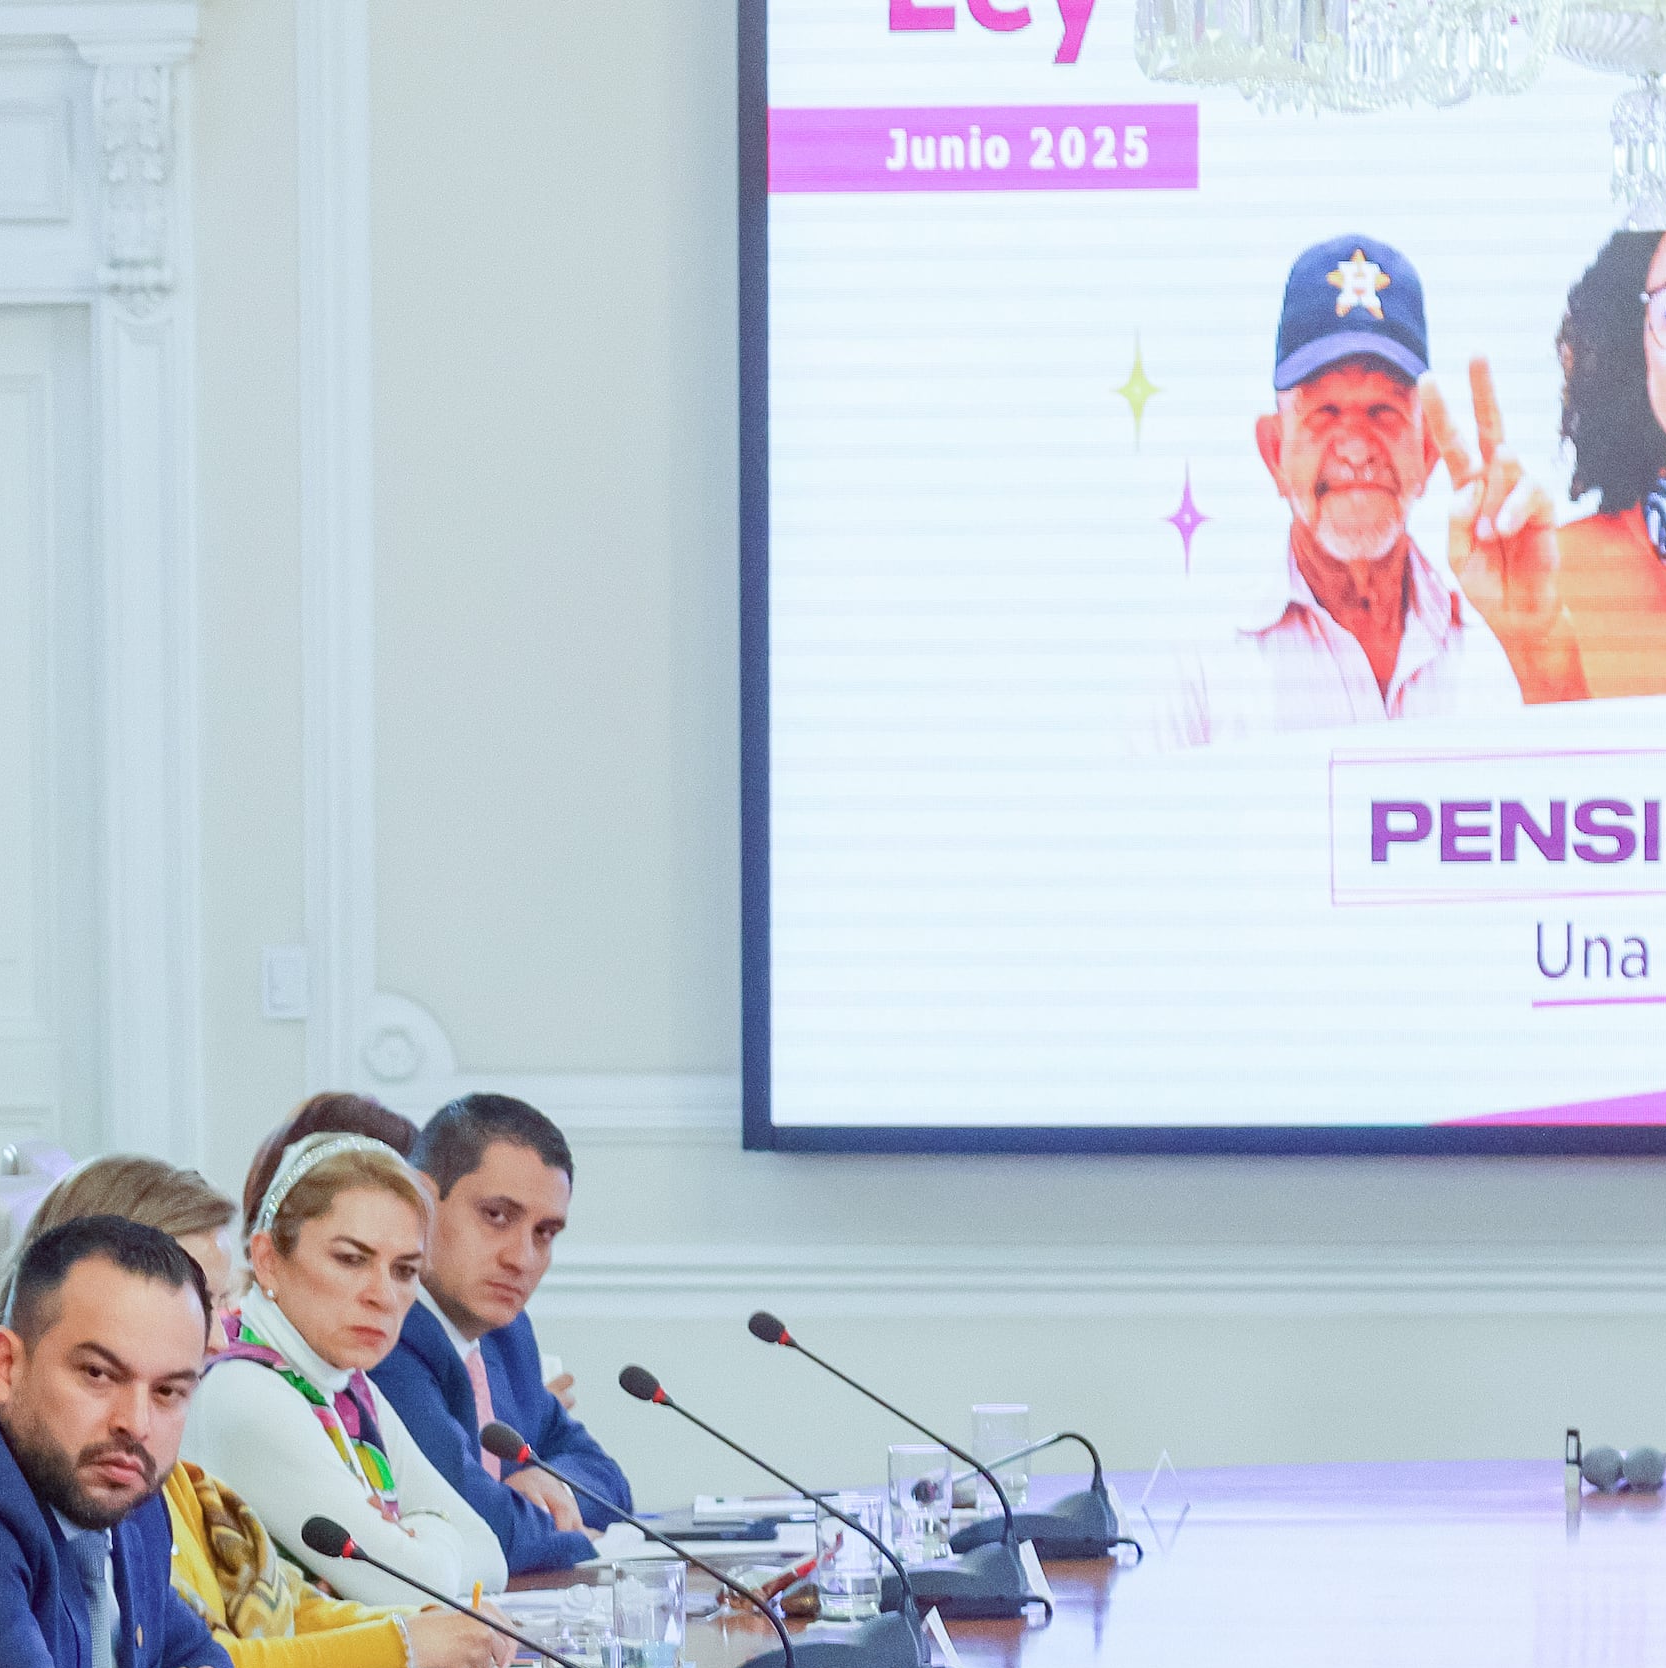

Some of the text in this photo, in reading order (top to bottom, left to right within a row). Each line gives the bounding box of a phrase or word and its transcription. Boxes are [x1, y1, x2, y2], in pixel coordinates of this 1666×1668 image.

[885, 125, 1151, 172] Junio 2025
[1535, 921, 1649, 980] Una
